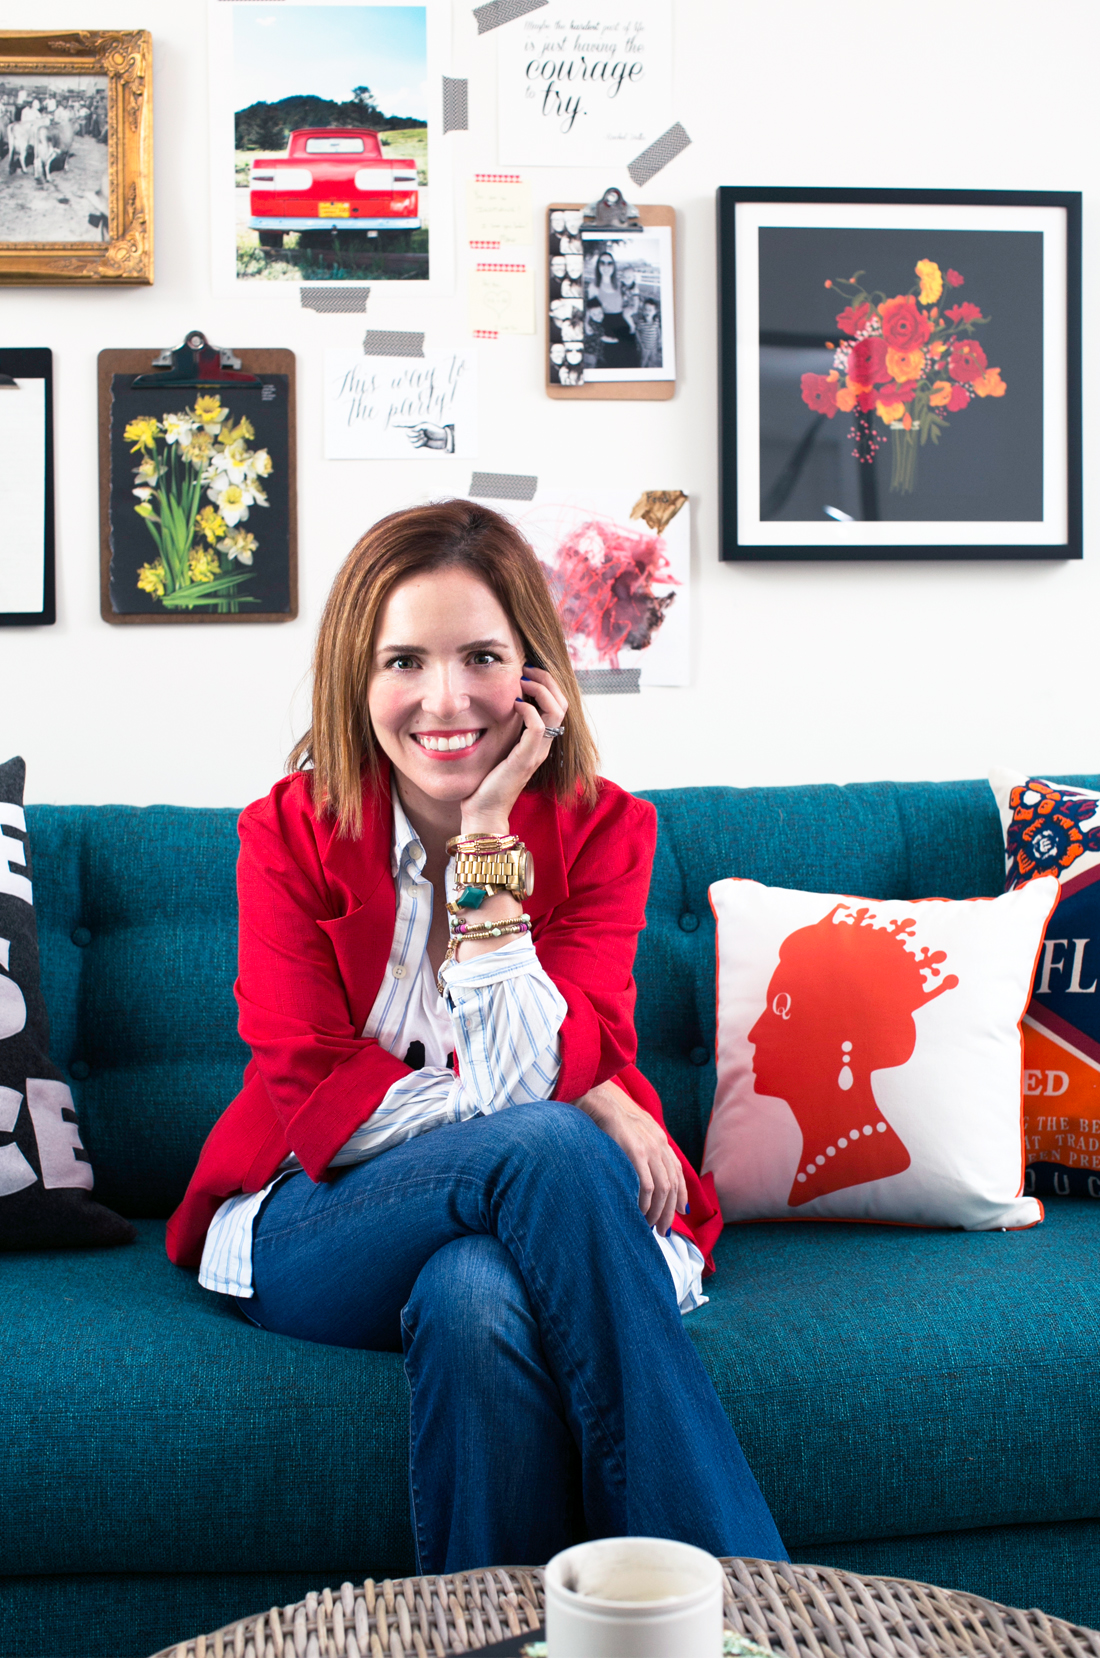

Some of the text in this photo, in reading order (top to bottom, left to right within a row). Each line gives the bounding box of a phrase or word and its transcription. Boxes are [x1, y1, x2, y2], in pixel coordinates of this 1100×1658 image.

[554, 19, 566, 31] the
[524, 34, 646, 60] is just having the
[525, 56, 646, 99] courage
[524, 80, 588, 134] to try.
[391, 367, 436, 397] way
[1036, 938, 1098, 994] FL
[772, 992, 792, 1020] Q
[1037, 1116, 1070, 1131] THE
[1079, 1118, 1100, 1134] BE
